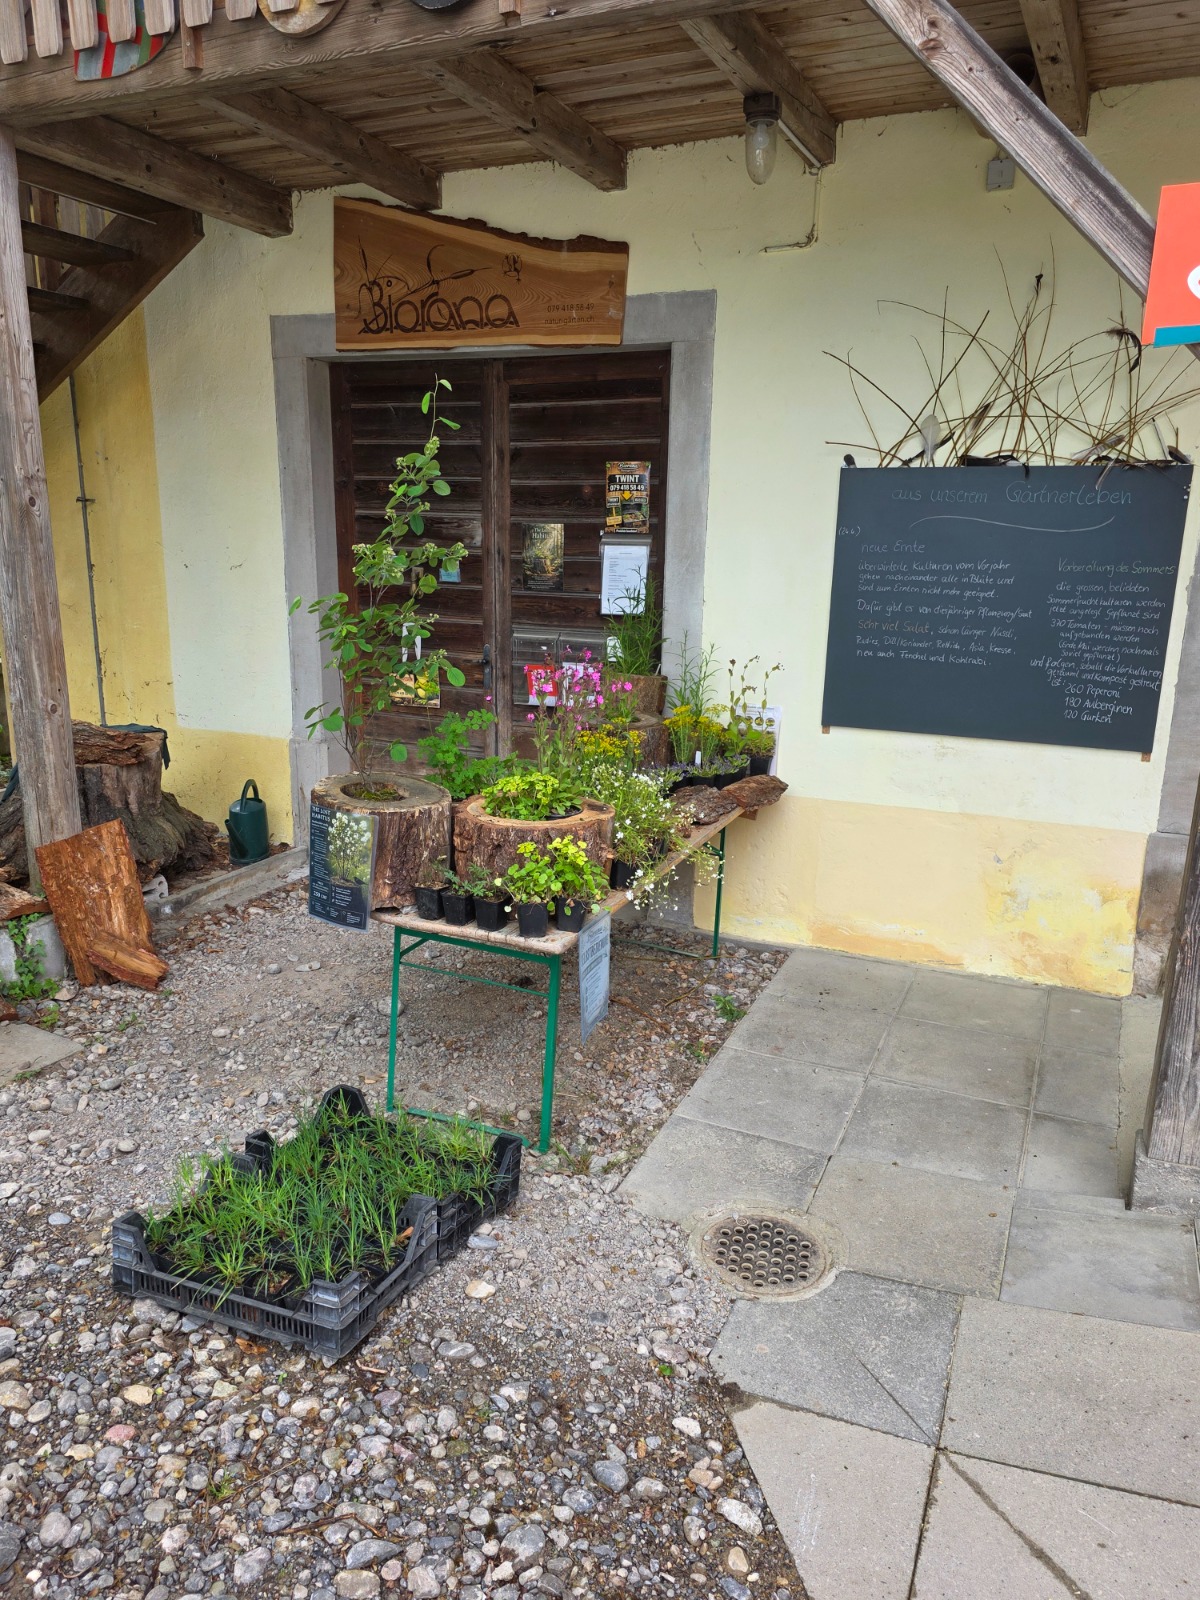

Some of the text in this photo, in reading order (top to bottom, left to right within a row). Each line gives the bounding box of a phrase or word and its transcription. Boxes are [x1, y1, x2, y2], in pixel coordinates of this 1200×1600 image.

[359, 279, 520, 335] Biorana
[547, 305, 560, 313] 079
[561, 303, 574, 312] 418
[585, 302, 595, 311] 49
[615, 474, 640, 483] TWINT
[891, 489, 922, 501] aus
[930, 489, 988, 504] unserem
[861, 540, 926, 553] neue Ernte
[858, 559, 1011, 573] überwinterte Kulturen vom Vorjahr
[1058, 557, 1177, 578] Vorbereitung des Sommers
[859, 573, 1016, 585] gehen nacheinander alle in Blüte und
[893, 583, 919, 593] Ernten
[921, 584, 942, 595] nicht
[942, 587, 960, 595] mehr
[962, 587, 999, 602] geeignet.
[1056, 581, 1150, 595] die grossen, beliebten
[856, 598, 883, 614] Dafür
[885, 601, 903, 617] gibt
[918, 605, 932, 614] von
[933, 605, 976, 620] diesjähriger
[1135, 598, 1166, 608] werden
[1048, 604, 1067, 616] jetzt
[1069, 607, 1102, 620] angelegt
[882, 619, 899, 631] viel
[902, 620, 933, 635] Salat,
[1050, 618, 1066, 628] 370
[1067, 619, 1101, 630] Tomaten
[1110, 621, 1136, 632] müssen
[1137, 625, 1159, 635] noch
[1059, 630, 1140, 643] aufgebunden werden
[1058, 639, 1159, 656] (Ende Mai werden nochmals
[856, 649, 992, 666] neu auch Fenchel und Kohlrabi.
[1030, 655, 1046, 667] und
[1079, 661, 1104, 671] sobald
[1104, 662, 1116, 672] die
[1116, 664, 1162, 679] Vorkulturen
[1081, 671, 1095, 680] und
[1093, 673, 1128, 685] Kompost
[1128, 677, 1160, 691] gestreut
[1064, 682, 1122, 698] 260 Peperoni
[1064, 696, 1133, 717] 180 Auberginen
[1063, 709, 1112, 724] 120 Gurken
